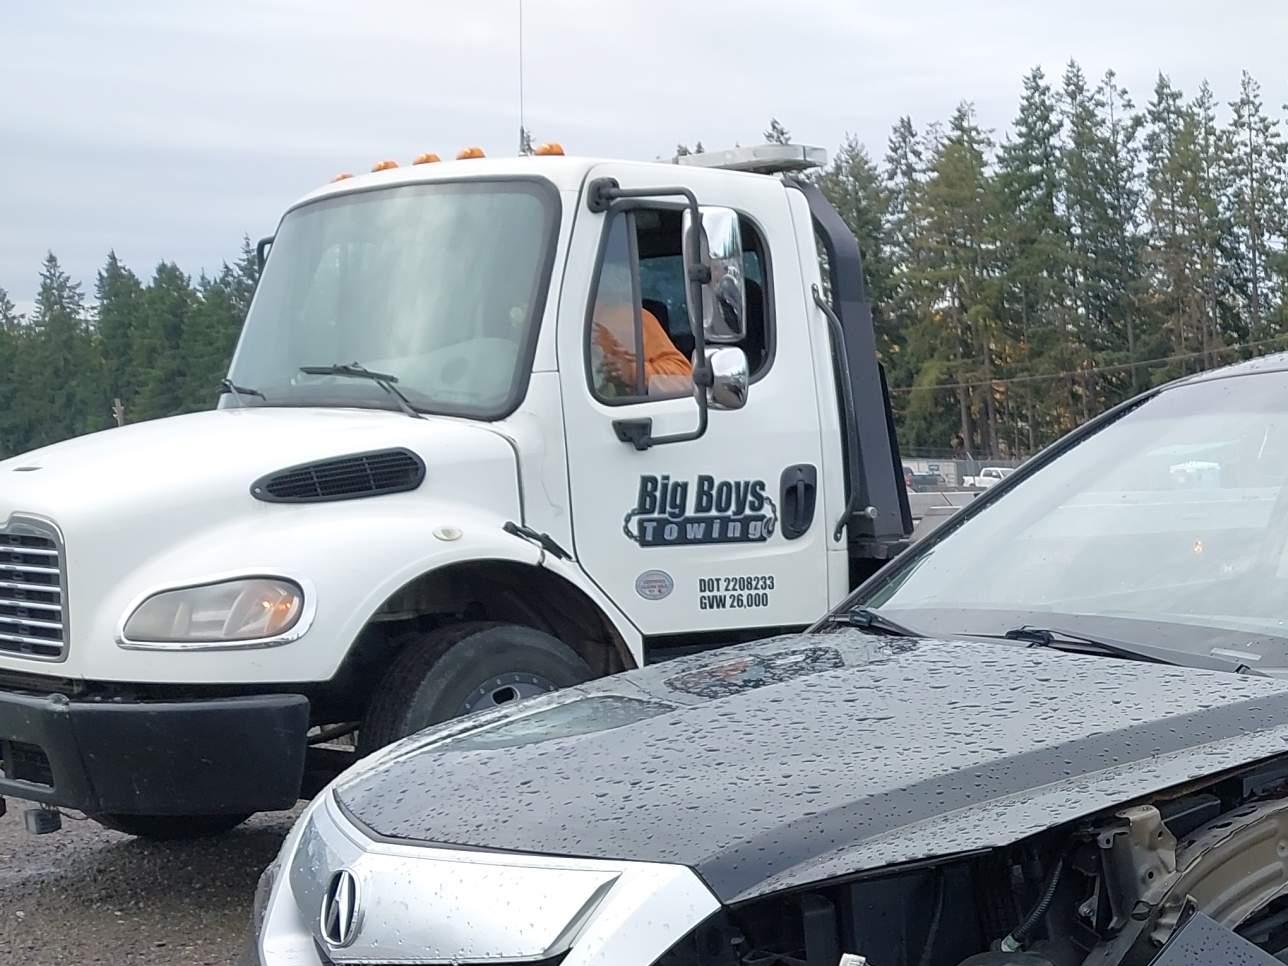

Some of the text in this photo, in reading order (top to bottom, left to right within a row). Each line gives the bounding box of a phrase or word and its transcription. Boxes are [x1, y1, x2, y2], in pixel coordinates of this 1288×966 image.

[637, 475, 766, 519] Big Boys
[643, 520, 763, 541] Towing
[698, 575, 775, 593] DOT 2208233
[699, 592, 768, 609] GVW 26,000
